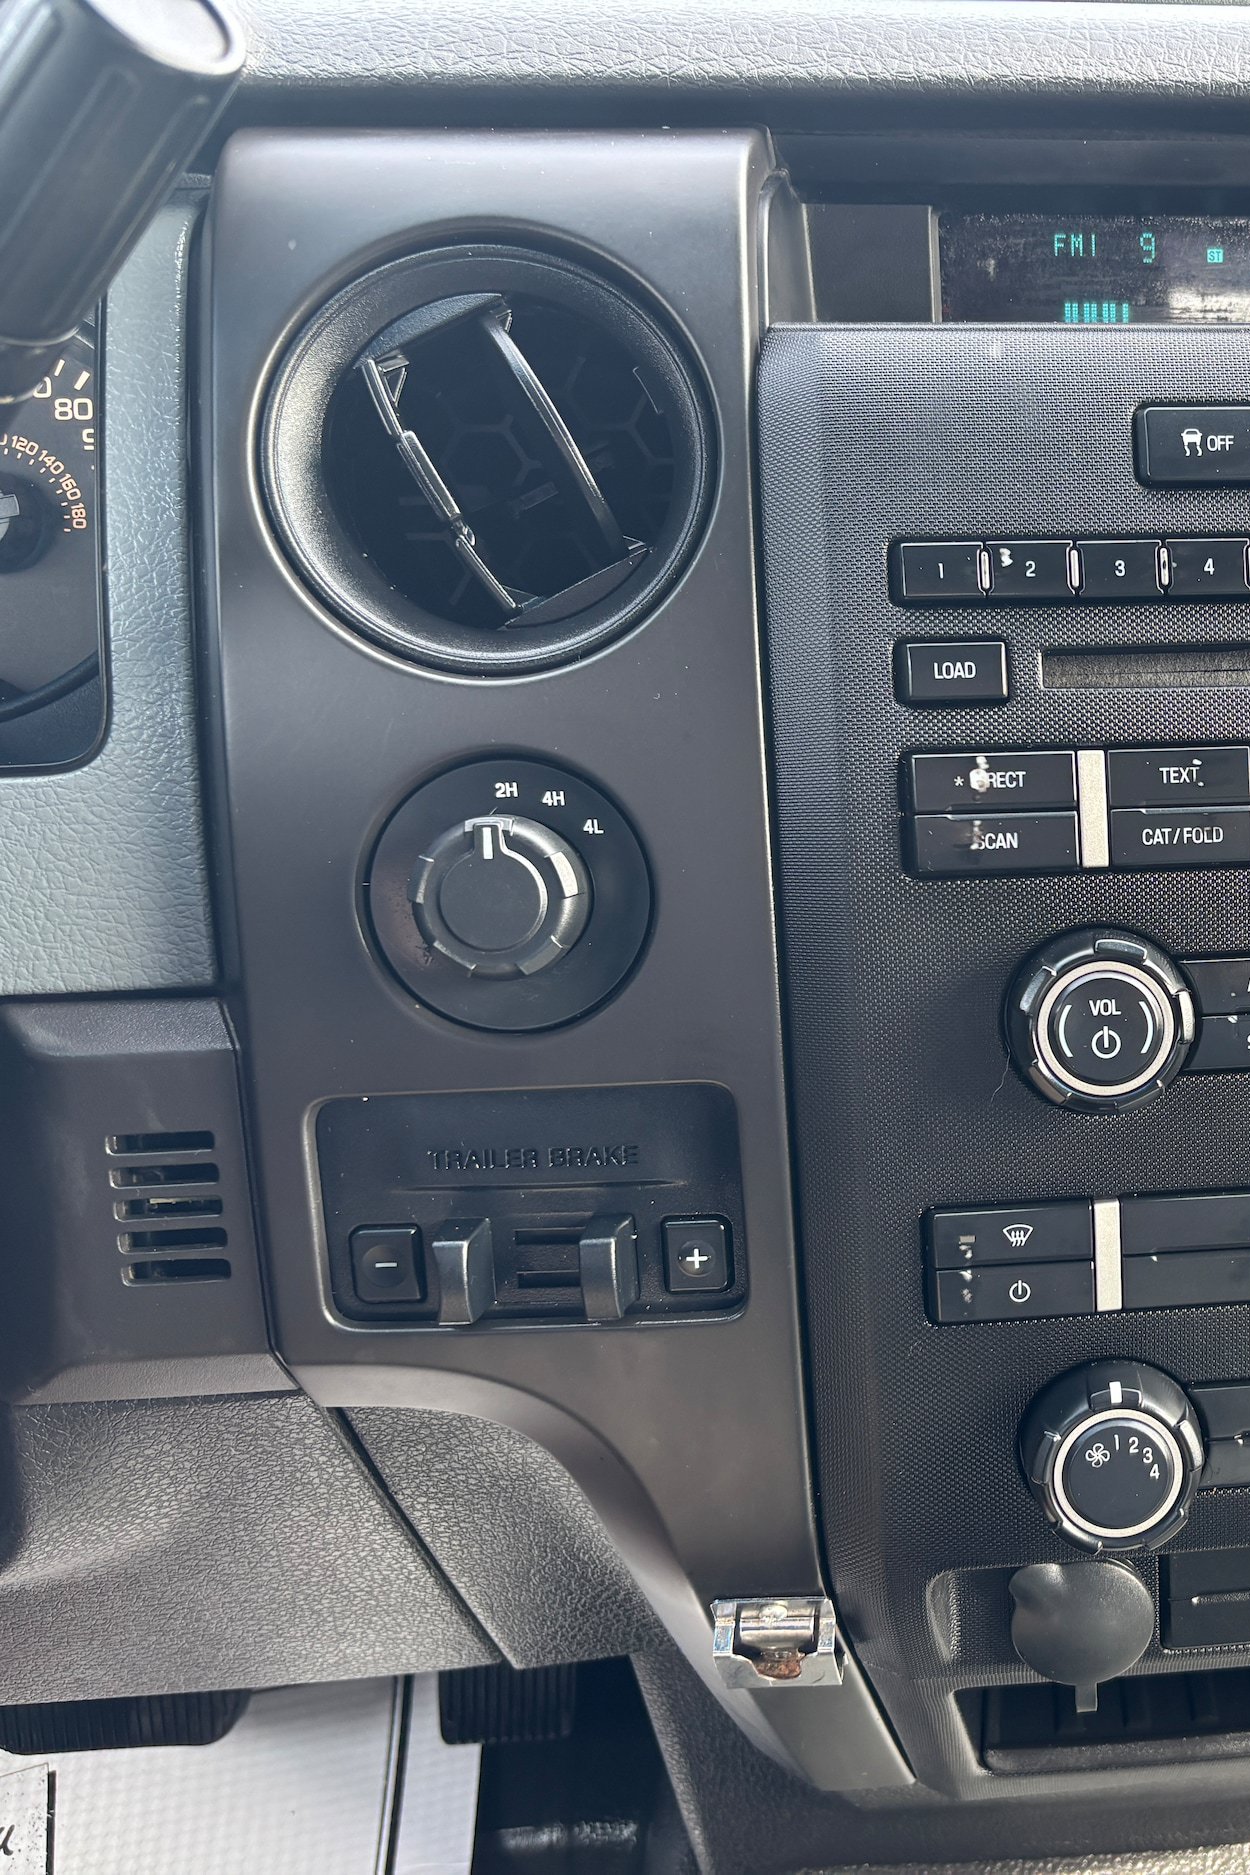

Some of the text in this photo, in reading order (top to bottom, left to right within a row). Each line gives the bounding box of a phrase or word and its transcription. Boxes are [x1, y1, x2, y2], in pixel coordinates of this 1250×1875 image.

[1208, 250, 1224, 263] ST
[54, 398, 93, 420] 80
[11, 435, 39, 456] 120
[1206, 434, 1235, 452] OFF
[38, 450, 65, 475] 140
[59, 474, 81, 501] 160
[71, 503, 87, 529] 180
[937, 562, 945, 579] 1
[1025, 560, 1036, 578] 2
[1114, 559, 1126, 577] 3
[1203, 557, 1215, 576] 4
[933, 660, 977, 681] LOAD
[1158, 766, 1200, 785] TEXT
[494, 781, 519, 799] 2H
[541, 790, 566, 807] 4H
[583, 818, 604, 835] 4L
[1141, 826, 1224, 846] CAT/FOLD
[1088, 998, 1122, 1017] VOL
[426, 1143, 641, 1171] TRAILER BRAKE
[1114, 1434, 1120, 1450] 1
[1128, 1436, 1139, 1454] 2
[1142, 1447, 1153, 1464] 3
[1149, 1463, 1160, 1480] 4
